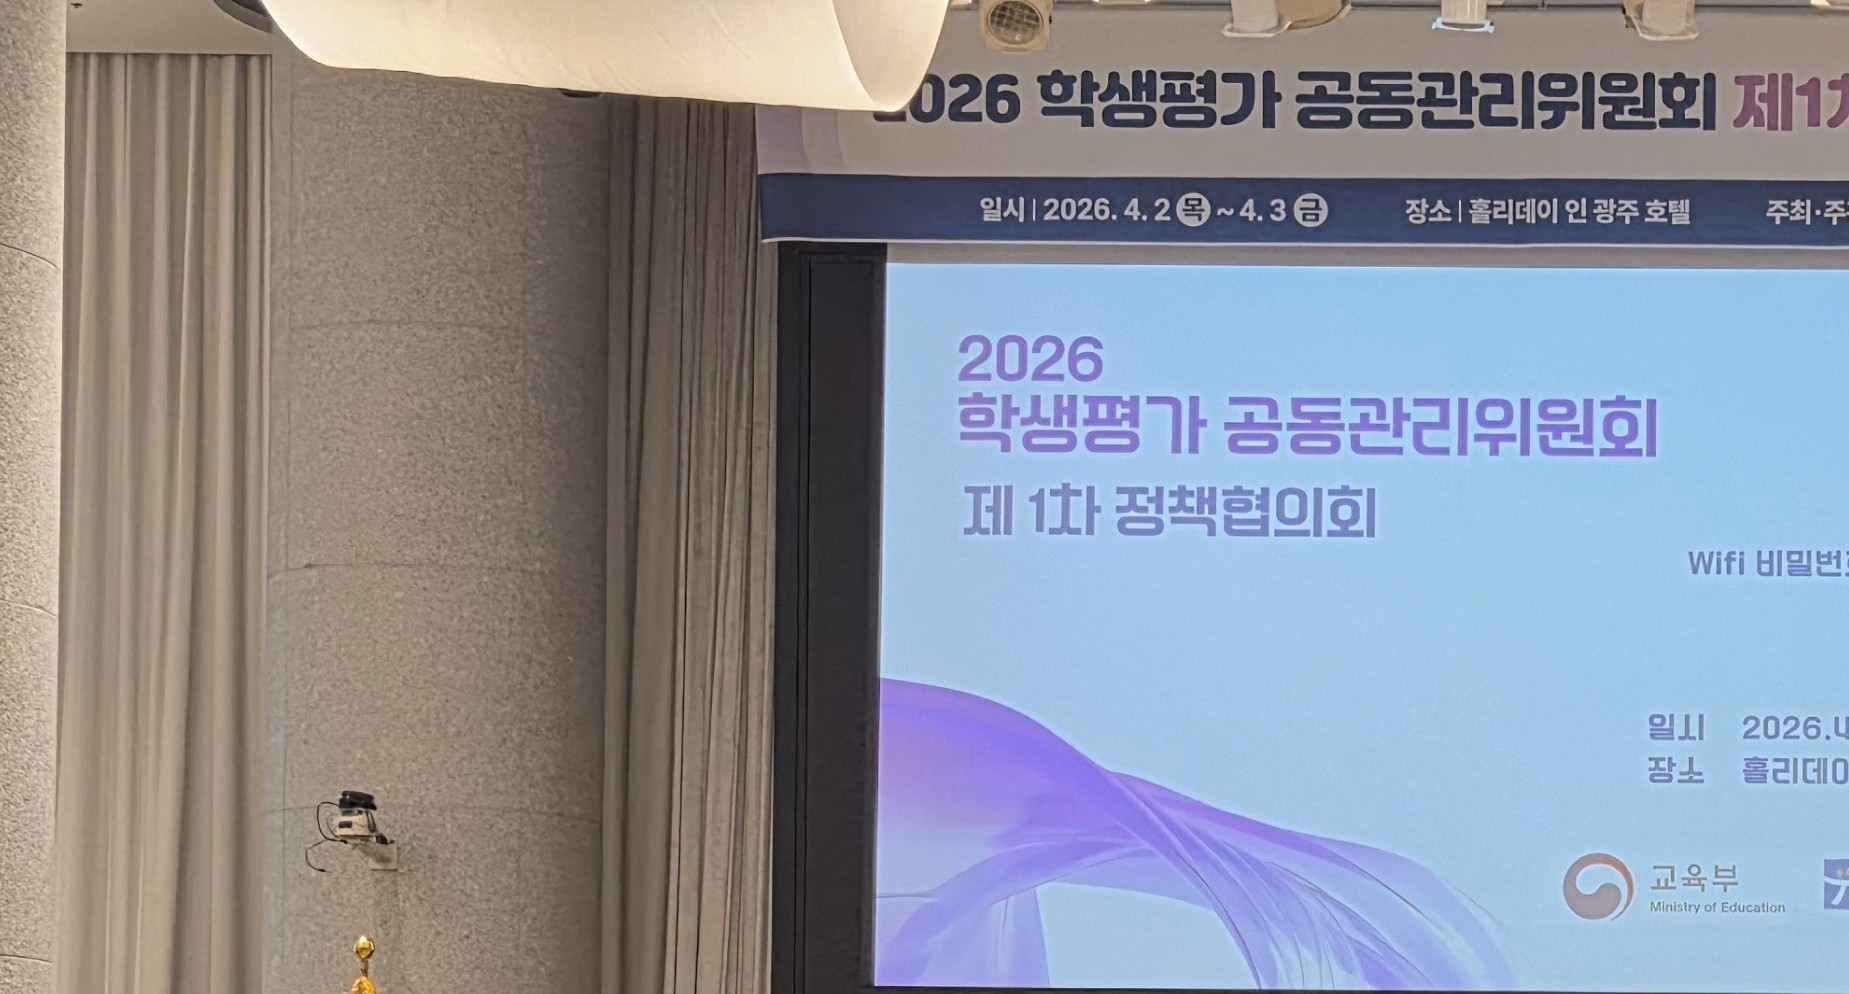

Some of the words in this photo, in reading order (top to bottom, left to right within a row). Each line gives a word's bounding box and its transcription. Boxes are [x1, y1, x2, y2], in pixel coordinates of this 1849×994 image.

[873, 73, 1021, 123] 026
[1037, 69, 1283, 129] 학생평가
[1296, 71, 1716, 130] 공동관리위원회
[981, 197, 1024, 222] 일시
[1406, 199, 1452, 224] 장소
[1593, 199, 1639, 224] 광주
[1645, 199, 1690, 224] 호텔
[959, 335, 1103, 382] 2026
[959, 392, 1207, 454] 학생평가
[1224, 395, 1656, 457] 공동관리위원회
[964, 485, 1013, 535] 제
[1029, 483, 1101, 535] 1차
[1116, 485, 1375, 537] 정책협의회
[1688, 551, 1744, 575] Wifi
[1649, 714, 1703, 740] 일시
[1648, 757, 1704, 783] 장소
[1651, 864, 1738, 892] 교육부
[1651, 902, 1700, 914] Ministry
[1705, 902, 1716, 912] of
[1722, 902, 1785, 913] Education
